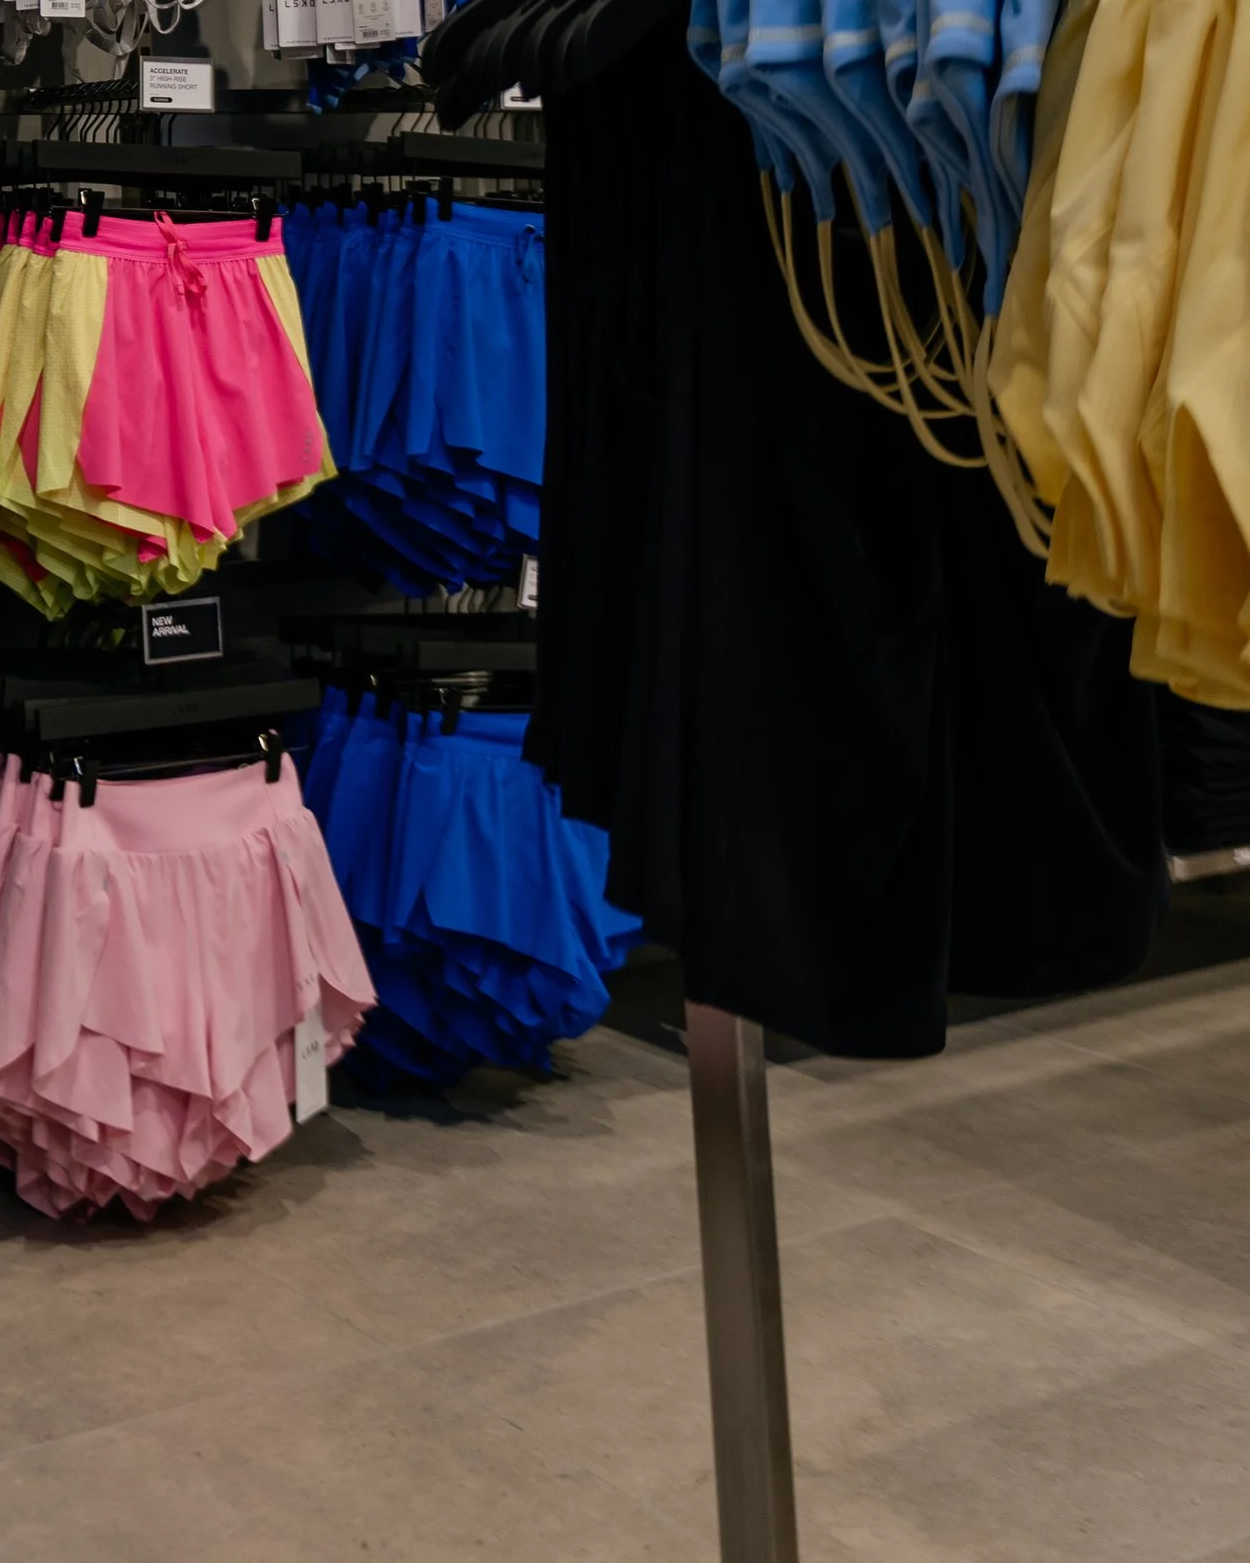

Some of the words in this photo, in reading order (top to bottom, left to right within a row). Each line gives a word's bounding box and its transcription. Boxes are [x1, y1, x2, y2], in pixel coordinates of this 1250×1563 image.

[284, 0, 315, 8] LSKD
[150, 67, 188, 75] ACCELERATE
[150, 82, 177, 90] RUNNING
[178, 83, 198, 91] SHORT
[152, 615, 173, 627] NEW
[152, 624, 190, 637] ARRIVAL
